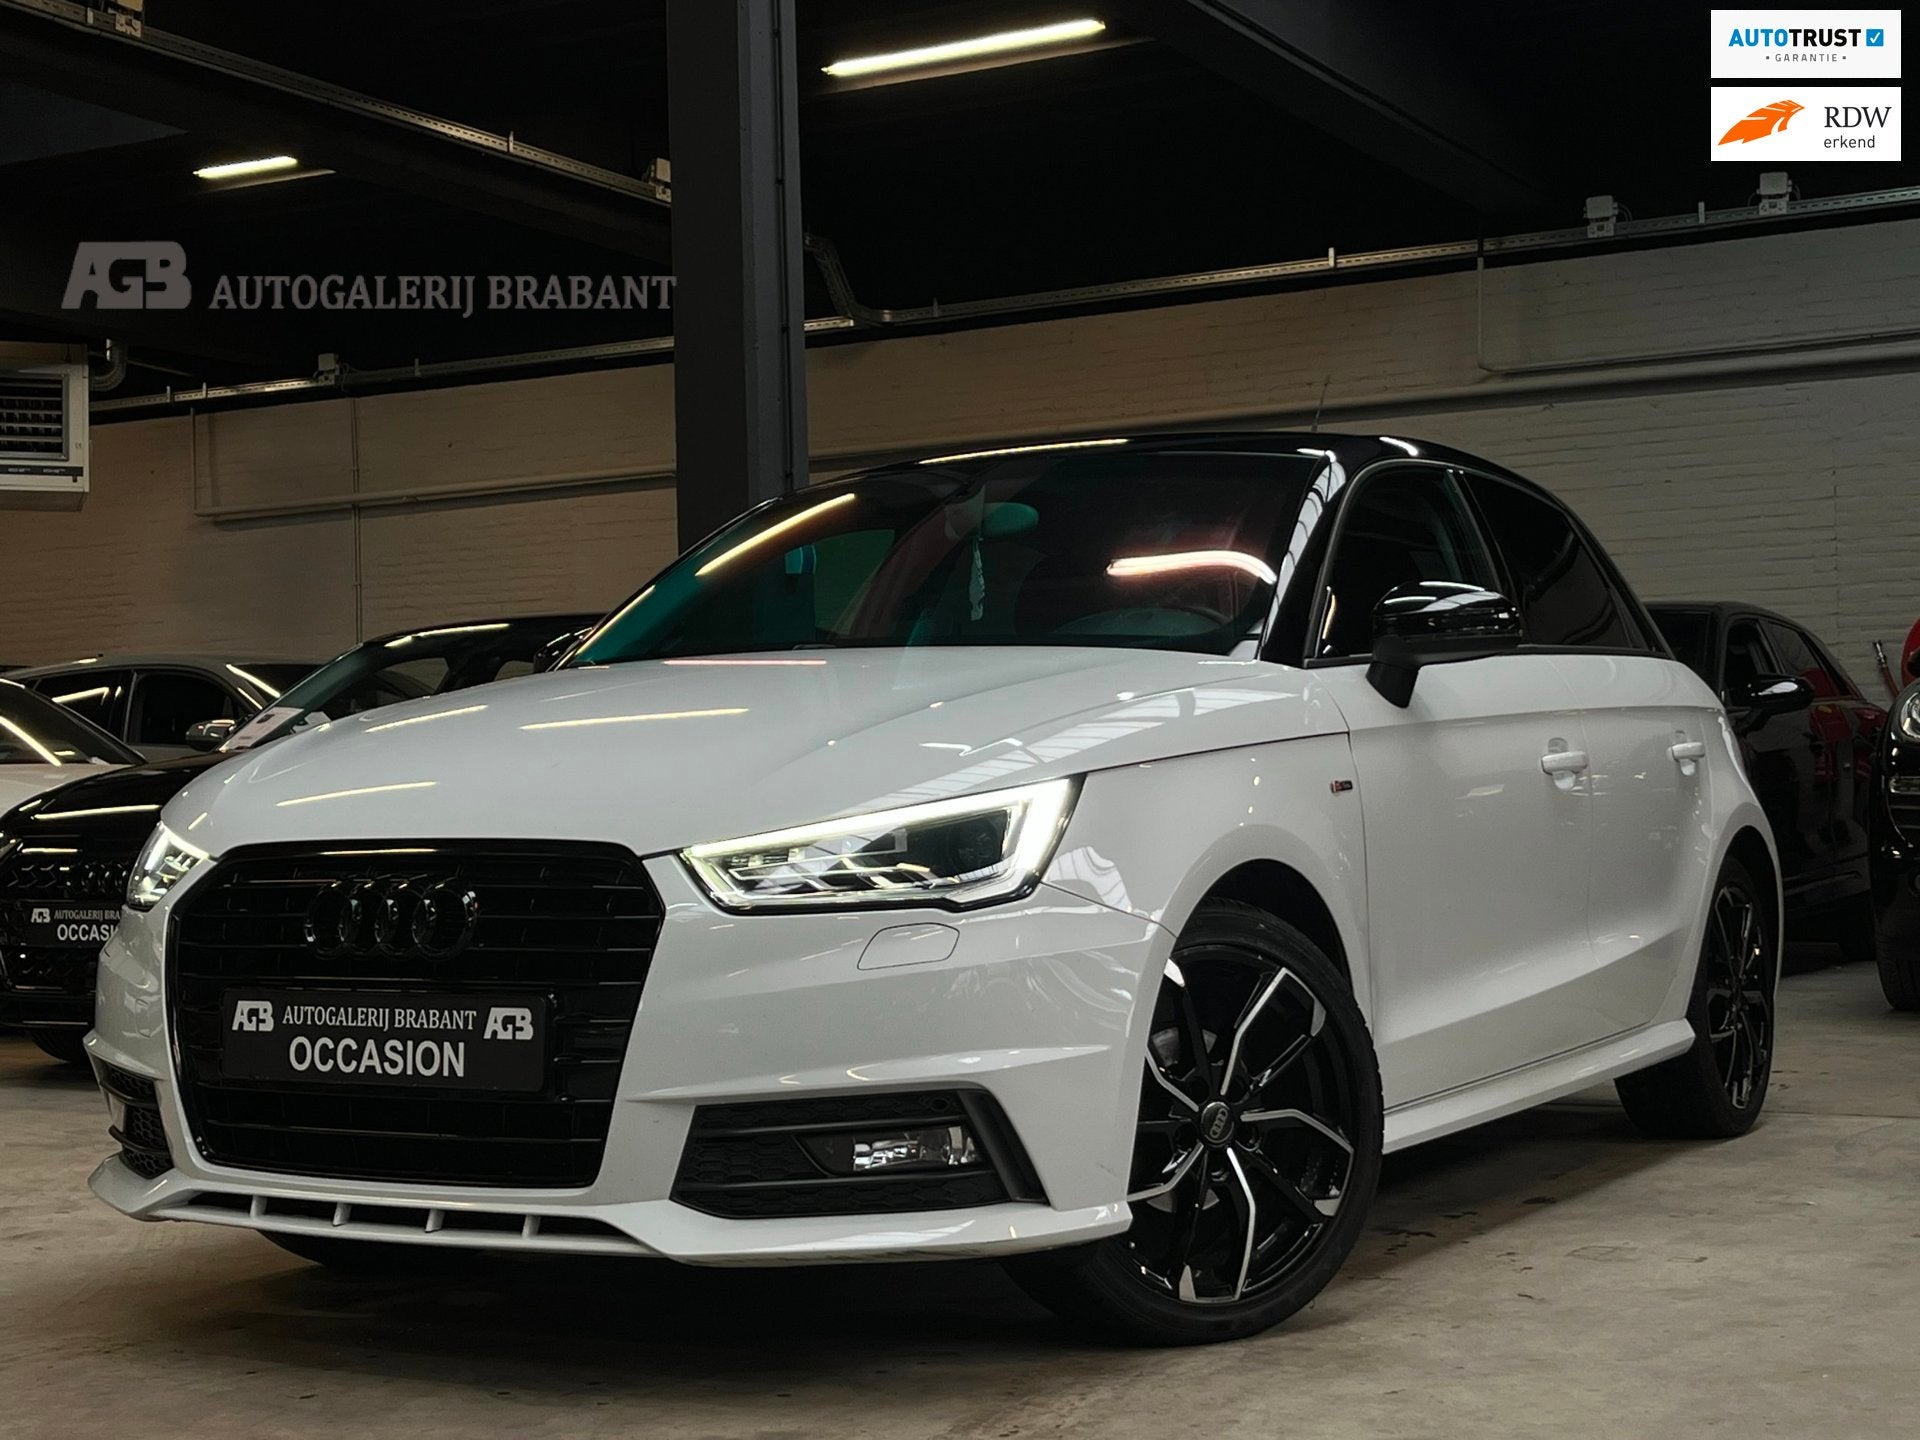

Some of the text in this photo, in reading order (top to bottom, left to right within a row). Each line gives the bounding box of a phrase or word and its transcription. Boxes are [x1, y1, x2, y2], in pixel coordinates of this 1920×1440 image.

[54, 909, 104, 922] AUTOGALERIJ
[231, 1000, 275, 1031] AGB
[282, 1005, 477, 1031] AUTOGALERIJ BRABANT
[483, 1006, 534, 1040] AGB
[289, 1036, 464, 1077] OCCASION
